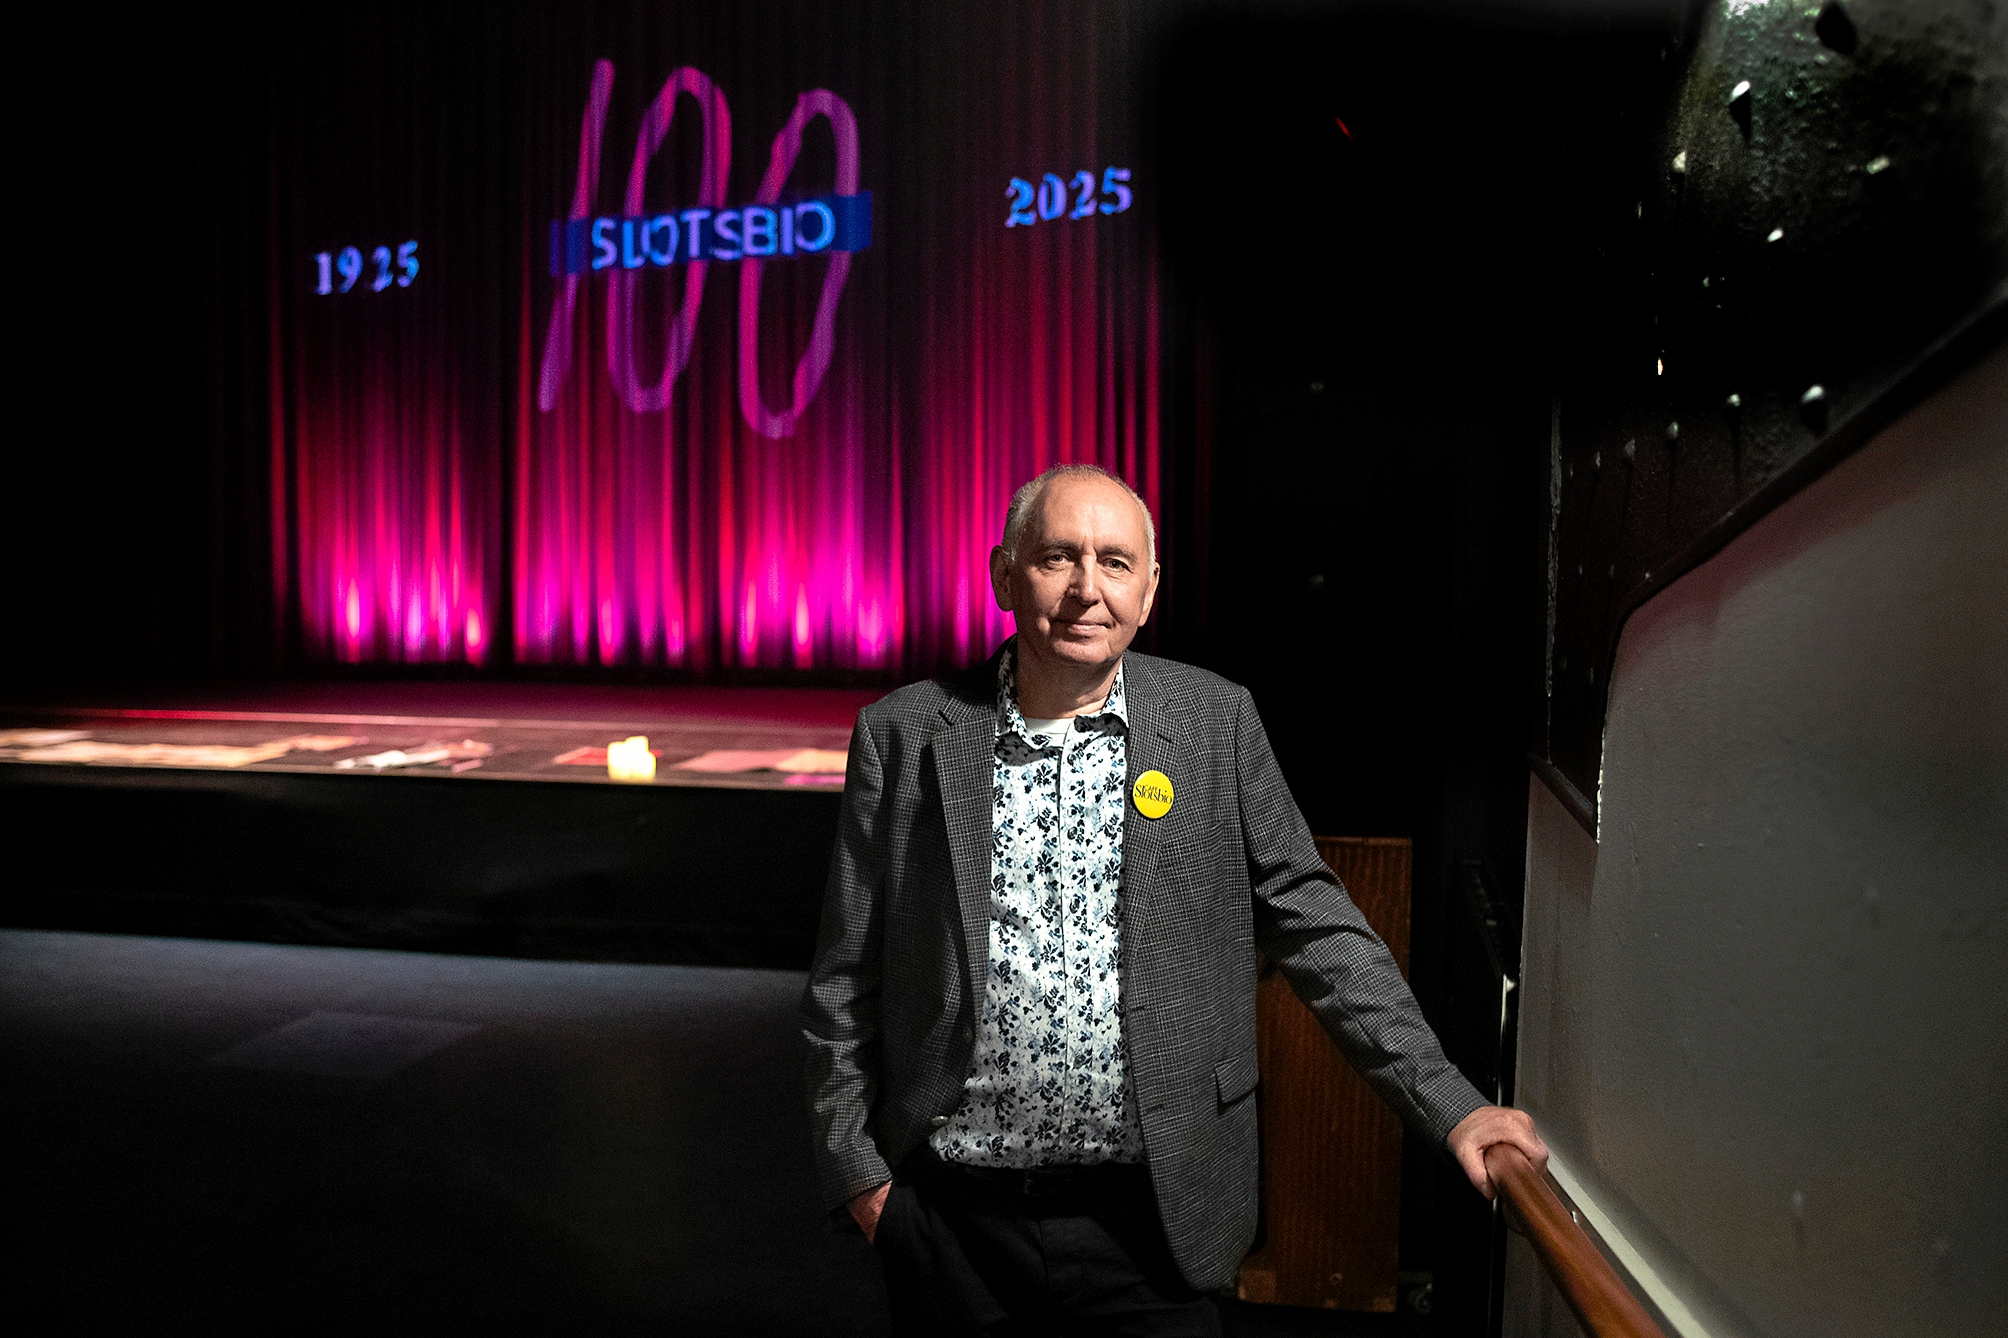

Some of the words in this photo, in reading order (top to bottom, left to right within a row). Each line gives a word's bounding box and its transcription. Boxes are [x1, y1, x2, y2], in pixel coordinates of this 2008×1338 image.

[1004, 166, 1132, 228] 2025
[538, 58, 859, 440] 100
[592, 200, 836, 270] SLOTSBIO
[314, 240, 419, 295] 1925
[1134, 784, 1173, 805] Slotsbio
